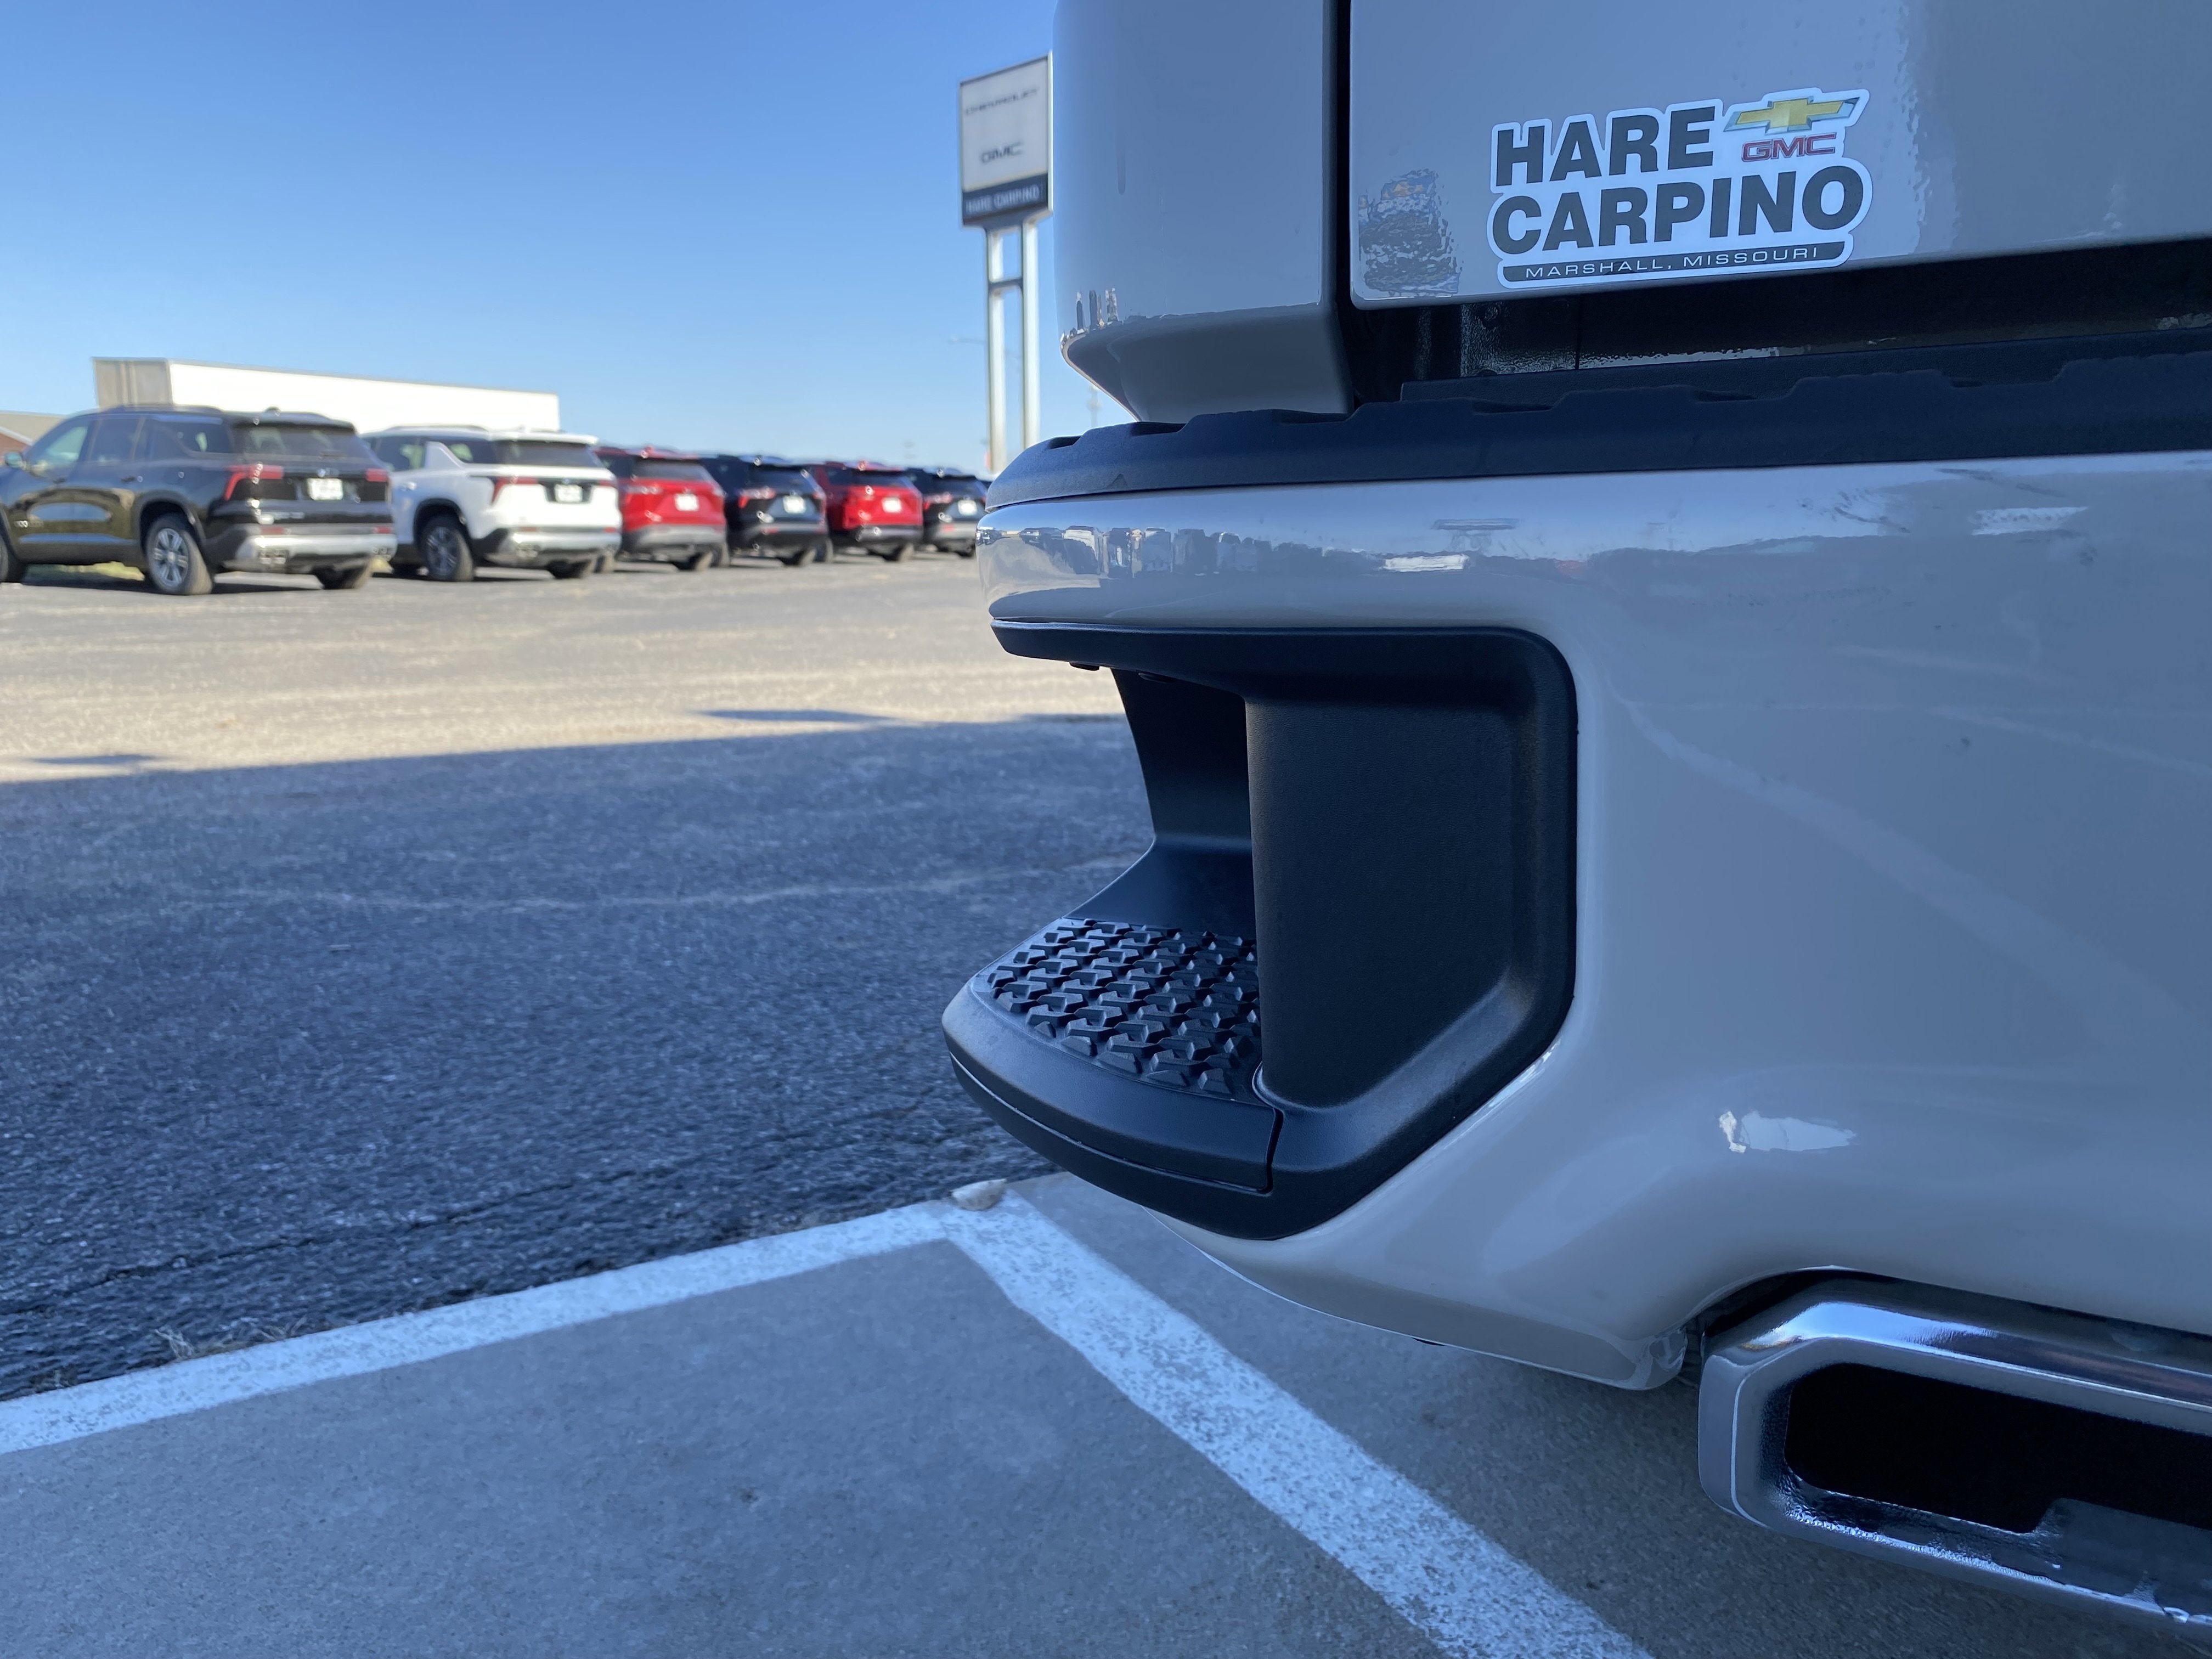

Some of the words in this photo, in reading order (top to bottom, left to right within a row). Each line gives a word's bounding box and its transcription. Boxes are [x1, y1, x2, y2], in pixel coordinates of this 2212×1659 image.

[980, 142, 1023, 163] GMC
[1496, 106, 1716, 187] HARE
[1742, 132, 1837, 162] GMC
[1492, 165, 1864, 255] CARPINO
[1526, 259, 1672, 278] MARSHALL,
[1683, 247, 1818, 268] MISSOURI
